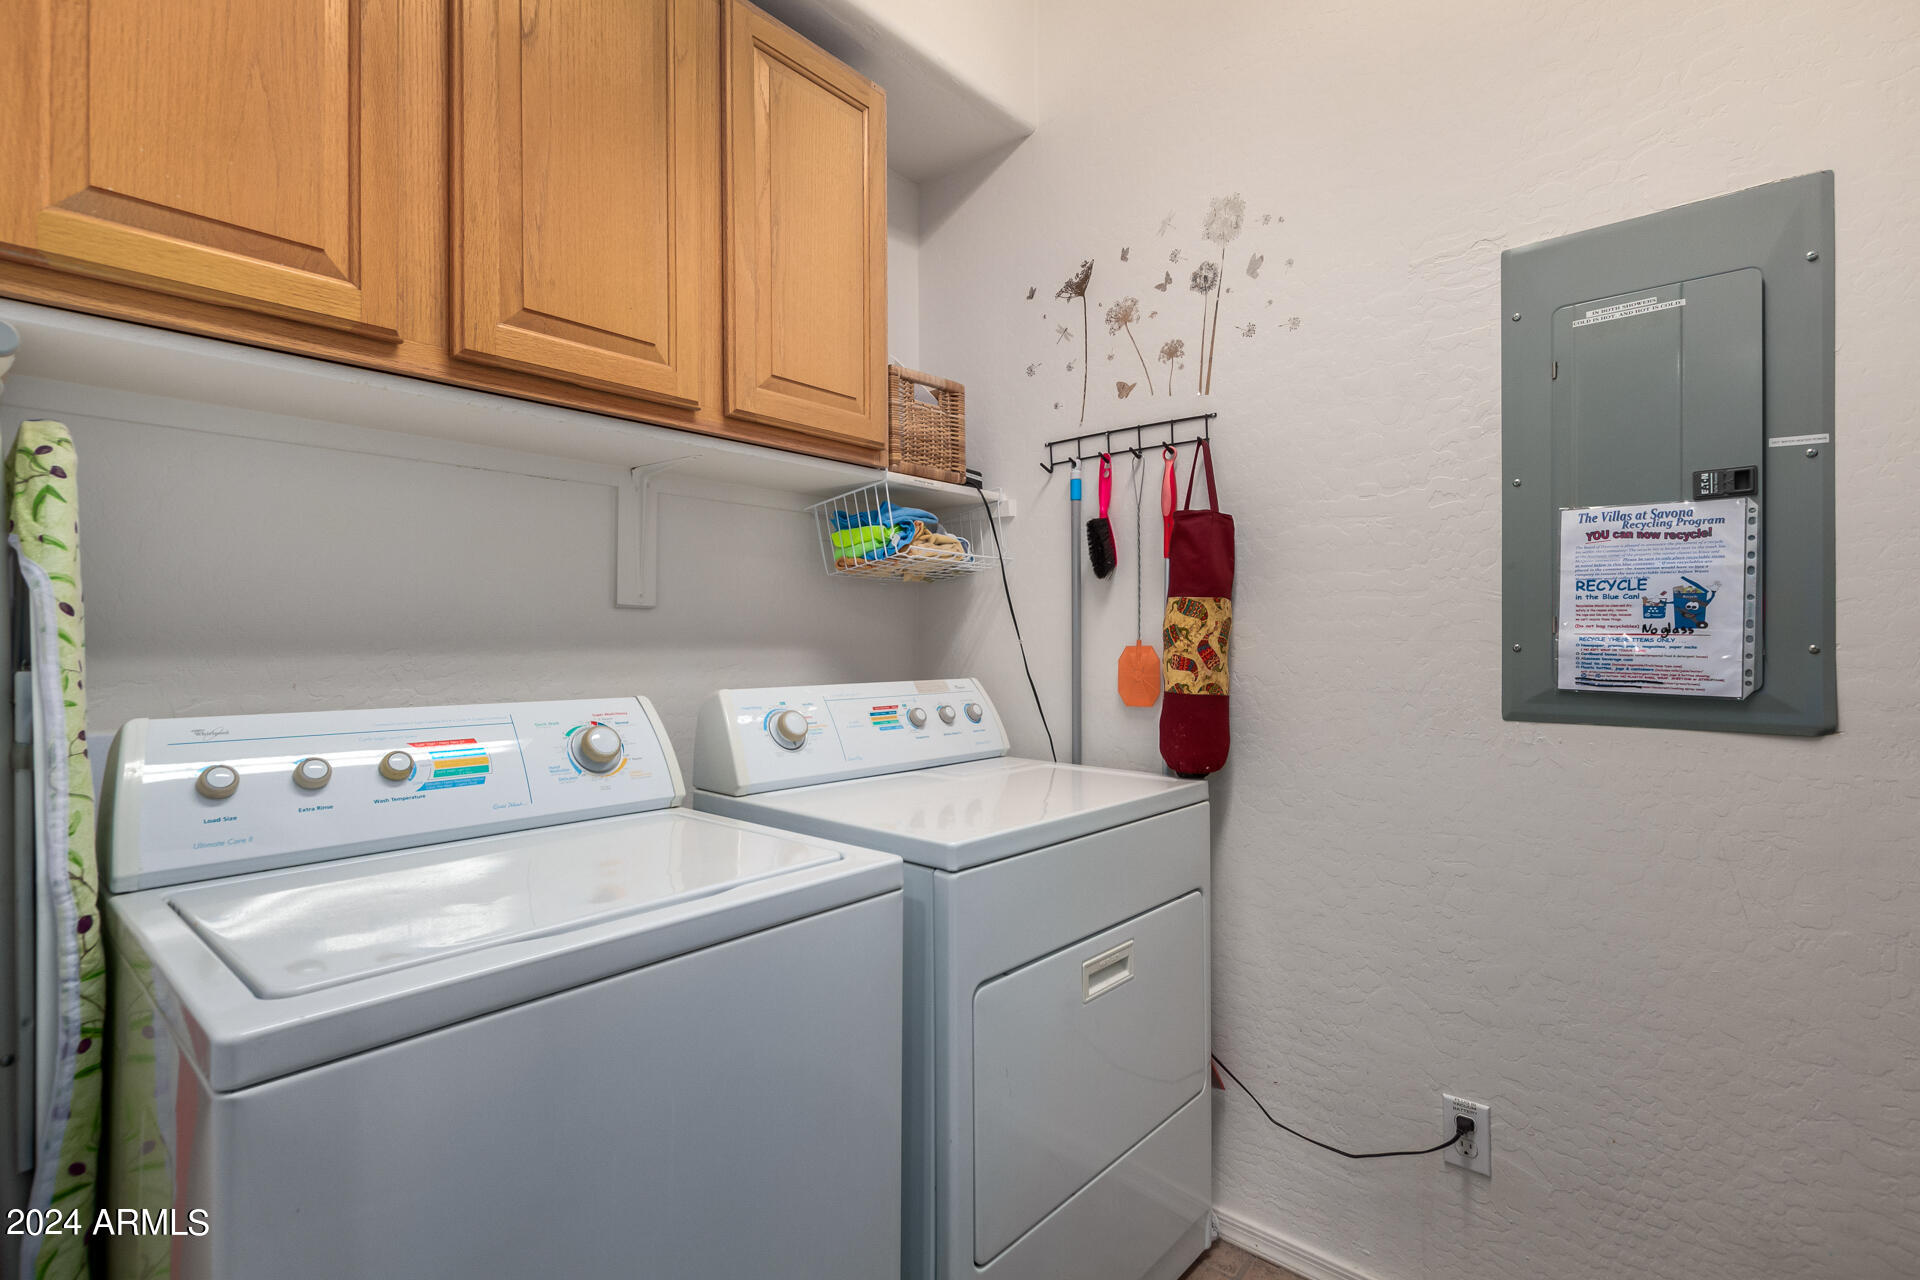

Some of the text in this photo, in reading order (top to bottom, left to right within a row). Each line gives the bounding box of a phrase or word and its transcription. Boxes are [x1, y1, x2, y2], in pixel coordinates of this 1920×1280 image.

[1618, 310, 1634, 318] AND
[1660, 300, 1682, 310] COLD
[1622, 298, 1657, 310] SHOWERS
[1578, 508, 1694, 524] The Villas at Savona
[1622, 516, 1726, 531] Recycling Program
[1585, 527, 1713, 542] YOU can now recycle!
[1575, 577, 1648, 592] RECYCLE
[1642, 622, 1695, 638] No glass
[373, 793, 427, 805] Wash Temperature
[298, 804, 334, 814] Extra Rinse
[203, 814, 238, 825] Load Size
[192, 839, 226, 850] Ultimate
[226, 837, 246, 848] Care
